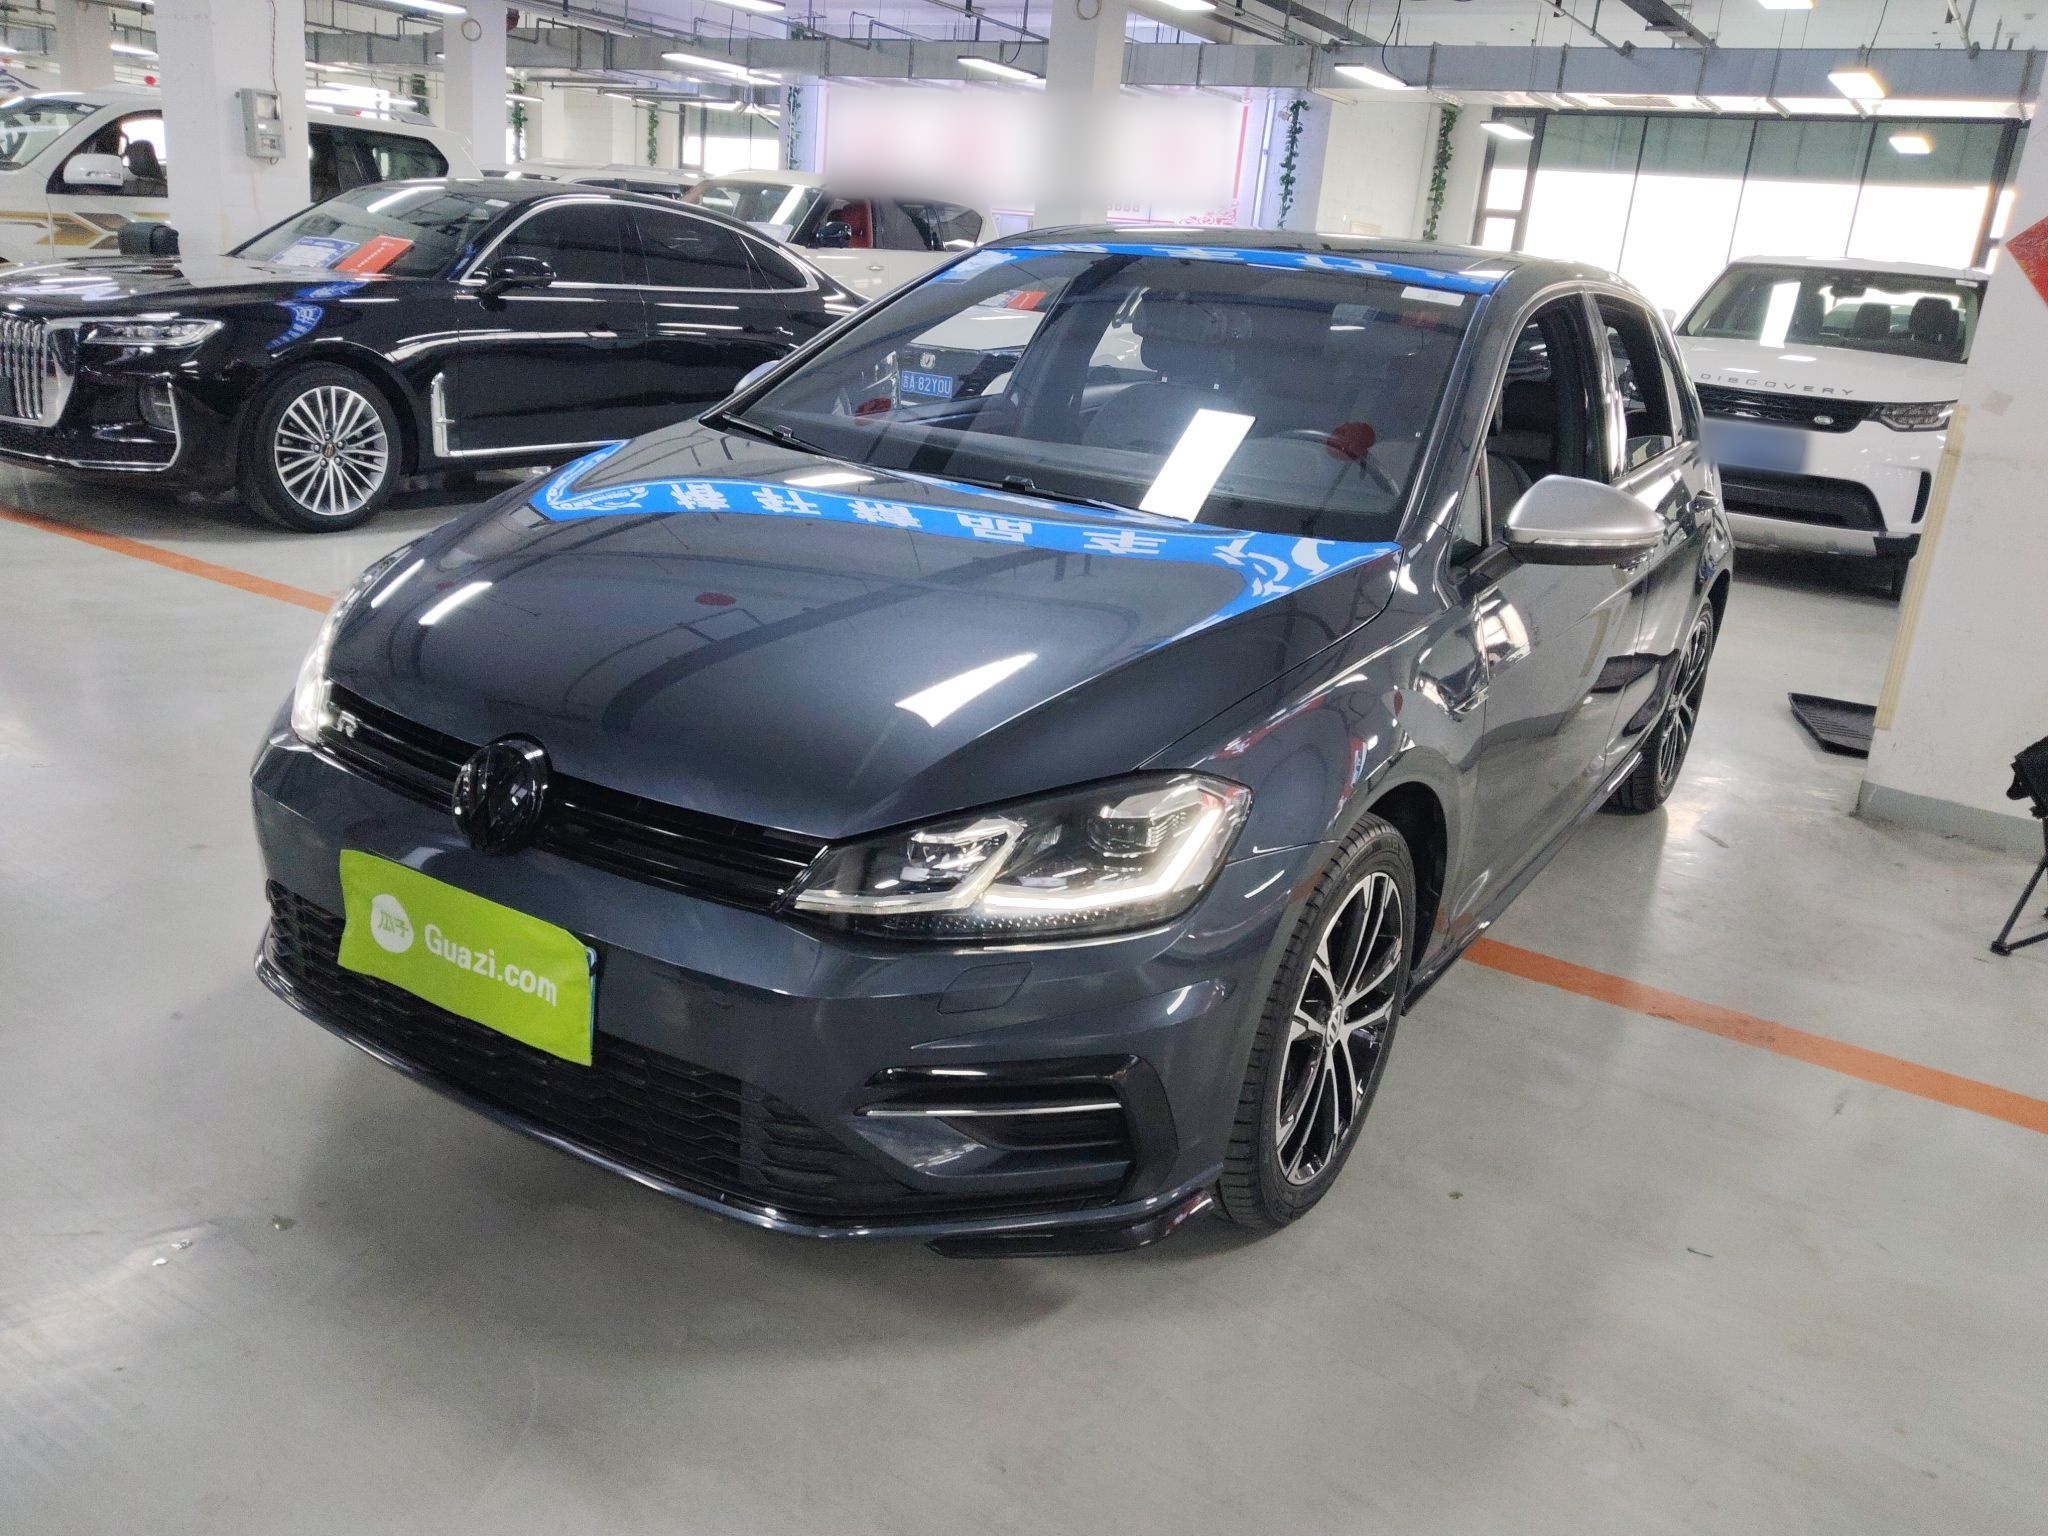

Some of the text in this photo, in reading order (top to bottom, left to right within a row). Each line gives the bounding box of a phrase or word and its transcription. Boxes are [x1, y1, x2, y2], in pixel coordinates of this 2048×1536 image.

[1700, 374, 1854, 395] DISCOVERY
[336, 710, 358, 738] R
[378, 910, 410, 938] 瓜子
[424, 923, 558, 1008] Guazi.com
